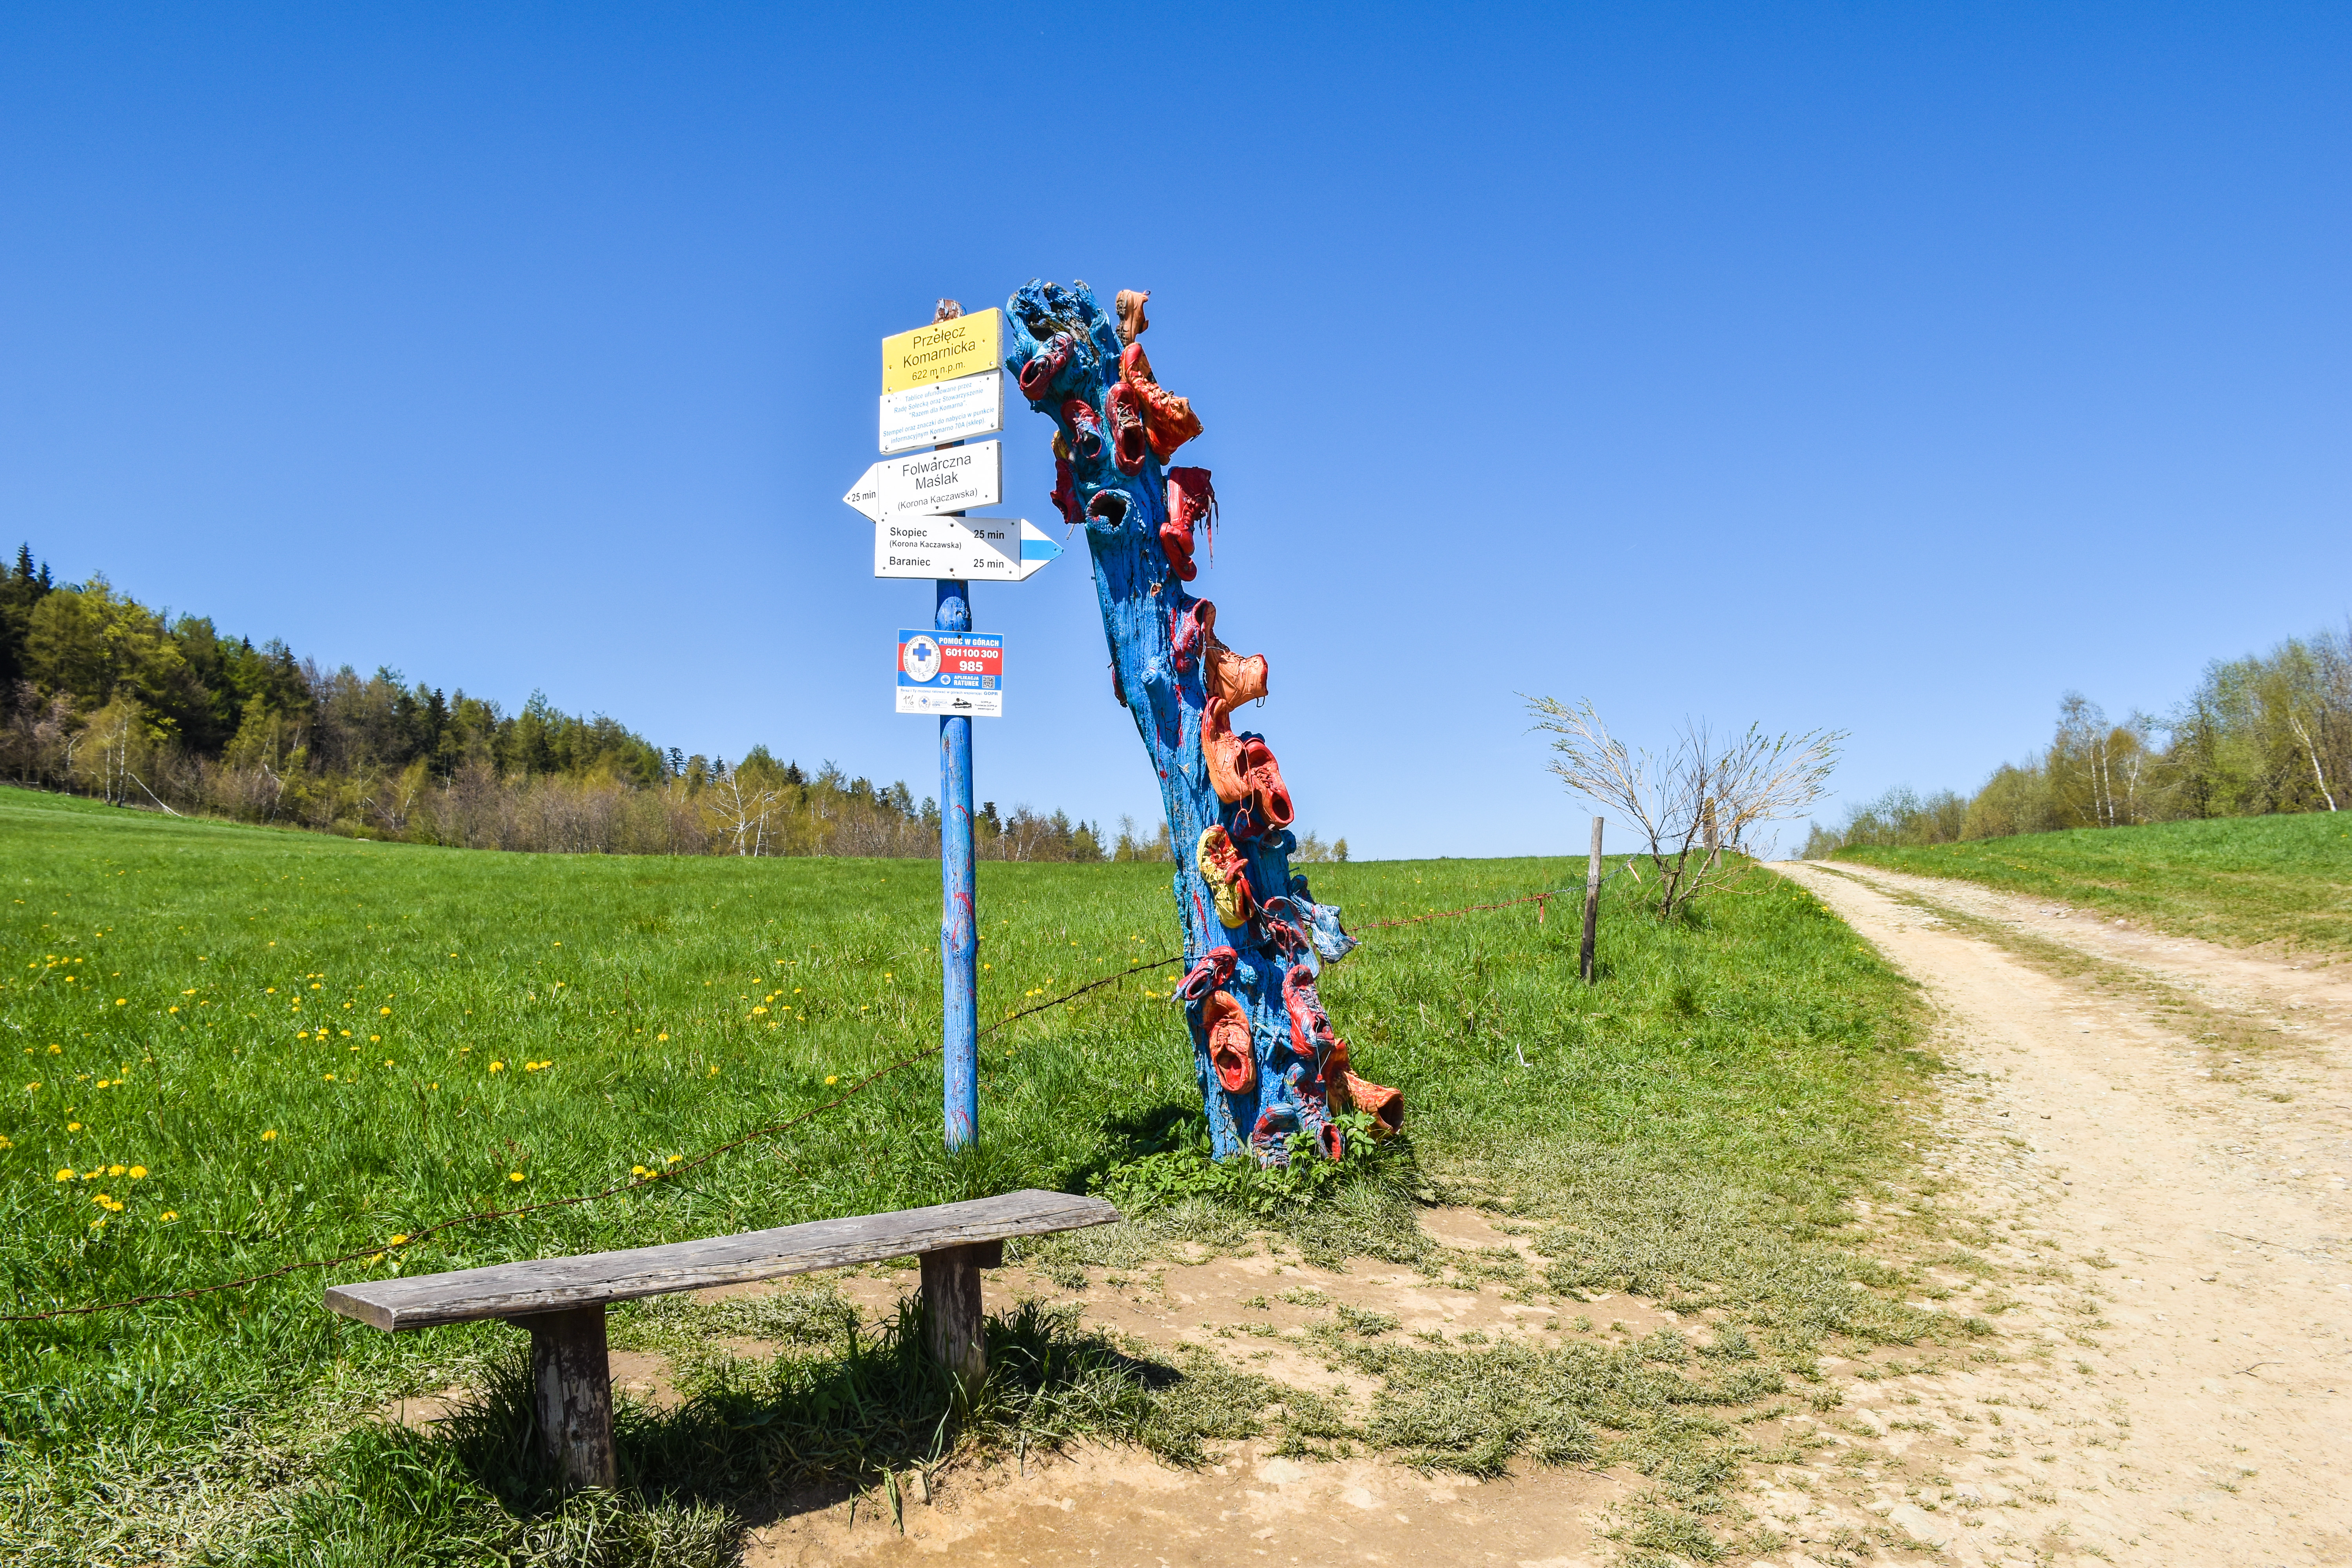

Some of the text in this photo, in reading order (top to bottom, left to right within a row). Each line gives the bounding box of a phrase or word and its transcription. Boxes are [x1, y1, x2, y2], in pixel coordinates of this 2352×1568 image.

[914, 327, 965, 349] Przełęcz
[904, 341, 975, 368] Komarnicka
[912, 361, 965, 380] 622 m n.p.m.
[906, 383, 972, 402] Tablice ufundowane przez
[909, 400, 928, 410] Sołecką
[943, 388, 983, 402] Stowarzyszenie
[883, 427, 904, 437] Stempel
[917, 419, 936, 429] znaczki
[946, 413, 966, 423] nabycia
[973, 407, 994, 416] punkcie
[891, 431, 928, 444] informacyjnym
[930, 425, 953, 435] Komarno
[966, 417, 985, 428] (sklep).
[903, 454, 971, 477] Folwarczna
[916, 472, 958, 490] Maślak
[851, 490, 876, 502] 25 min
[898, 488, 977, 511] (Korona Kaczawska)
[890, 528, 1004, 539] Skopiec 25 min
[889, 540, 962, 550] (Korona Kaczawska)
[889, 557, 1004, 568] Baraniec 25 min
[921, 637, 938, 651] POGOTOWIE
[973, 638, 999, 646] GÓRACH
[946, 648, 998, 658] 601 100 300
[960, 661, 983, 672] 985
[903, 695, 913, 705] 1%
